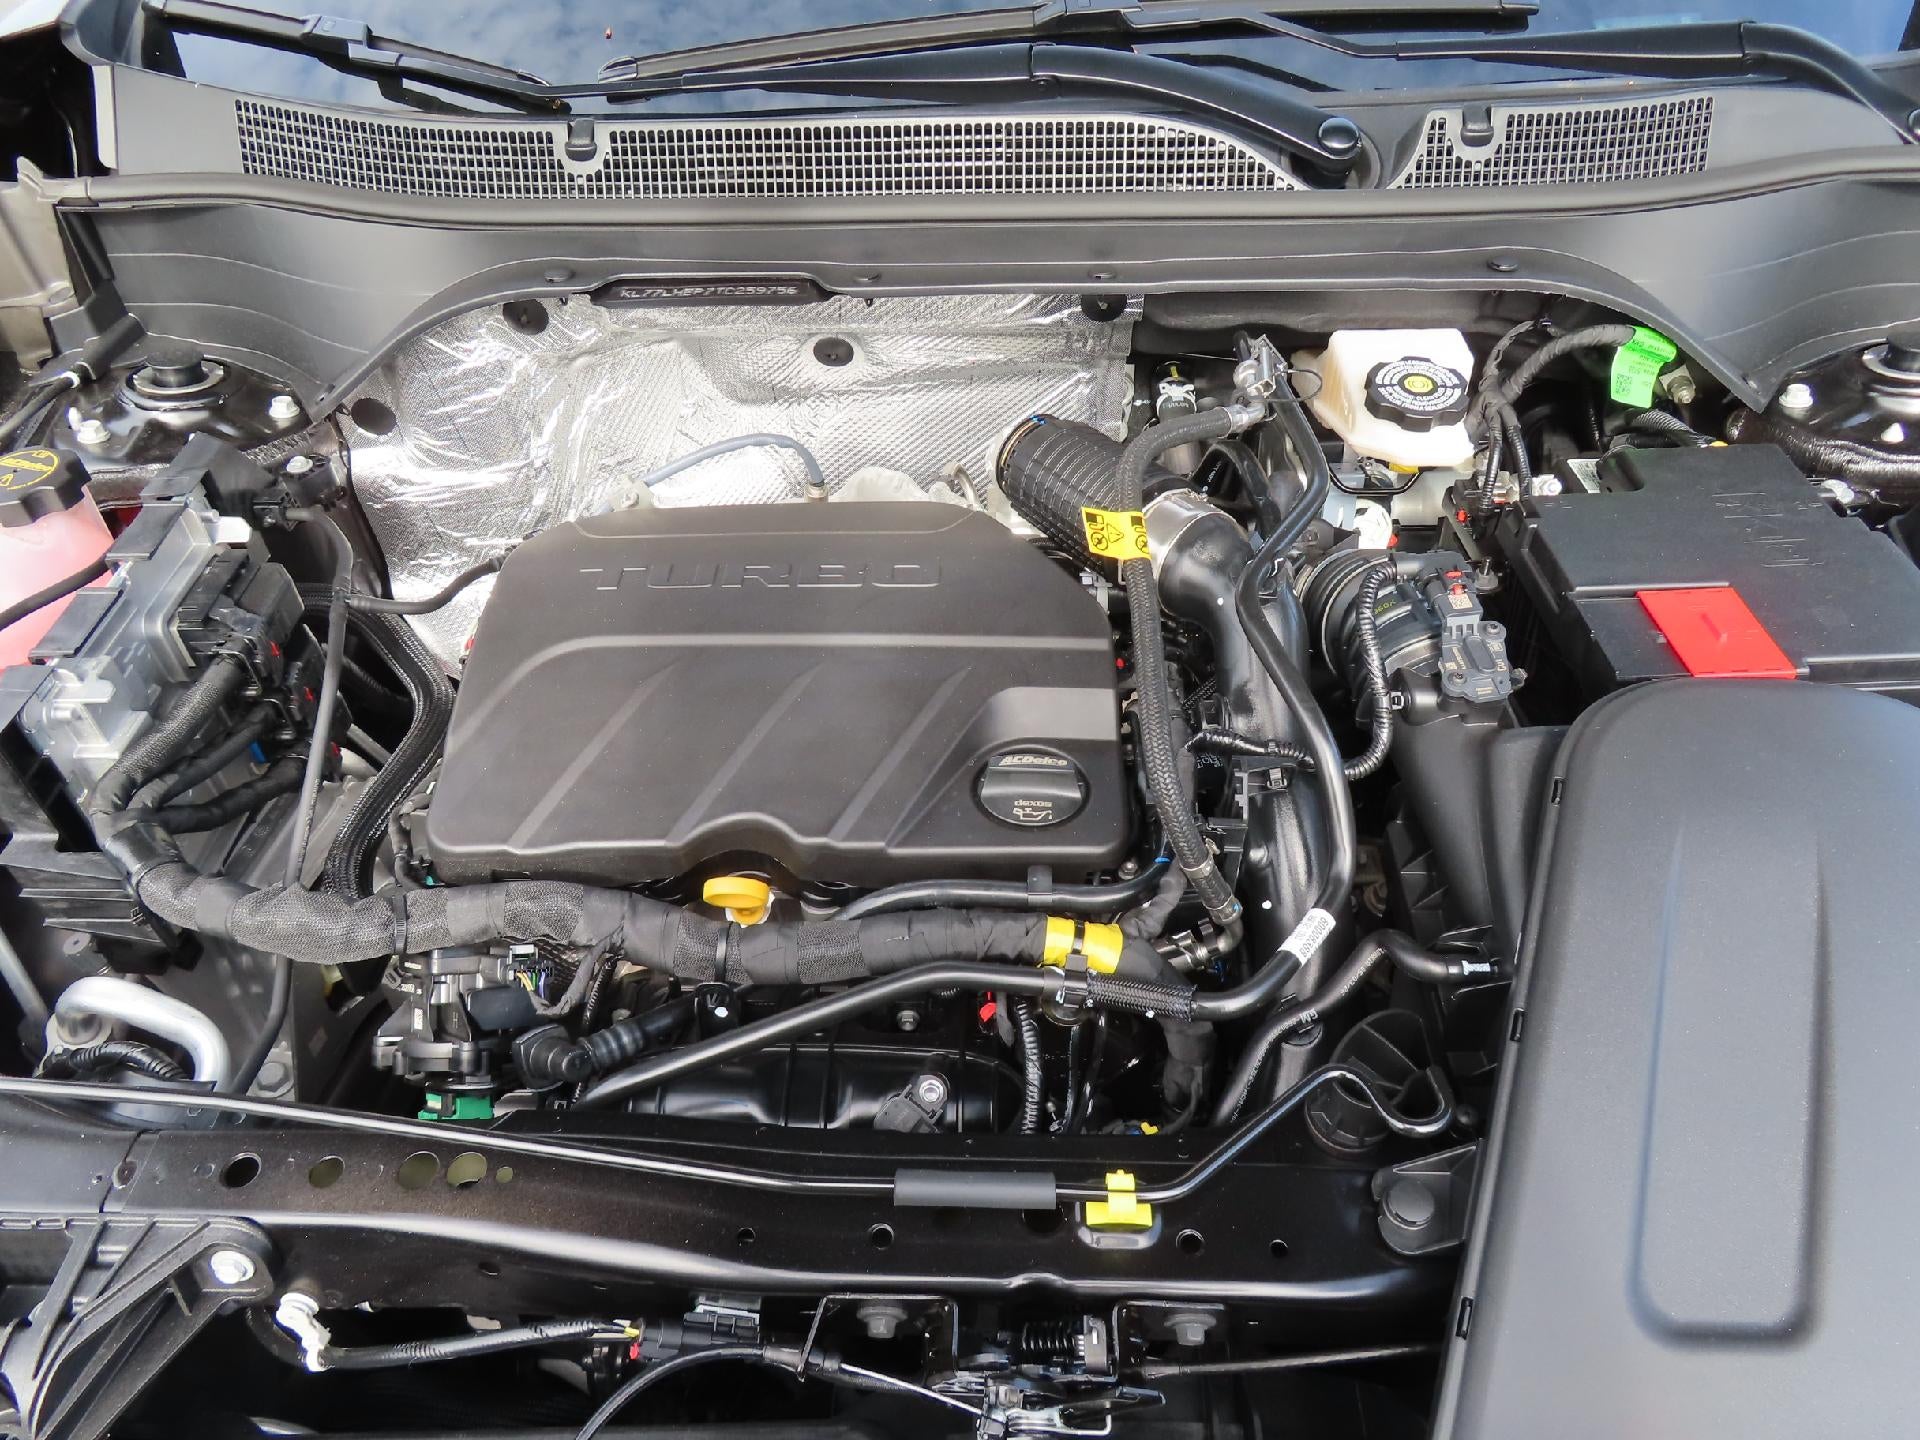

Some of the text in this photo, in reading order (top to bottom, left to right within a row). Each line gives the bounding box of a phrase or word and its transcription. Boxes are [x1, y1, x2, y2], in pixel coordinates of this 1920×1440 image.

[620, 286, 798, 298] KL77LHEP7TC259756
[578, 562, 942, 590] TURBO
[998, 755, 1068, 767] ACDelco
